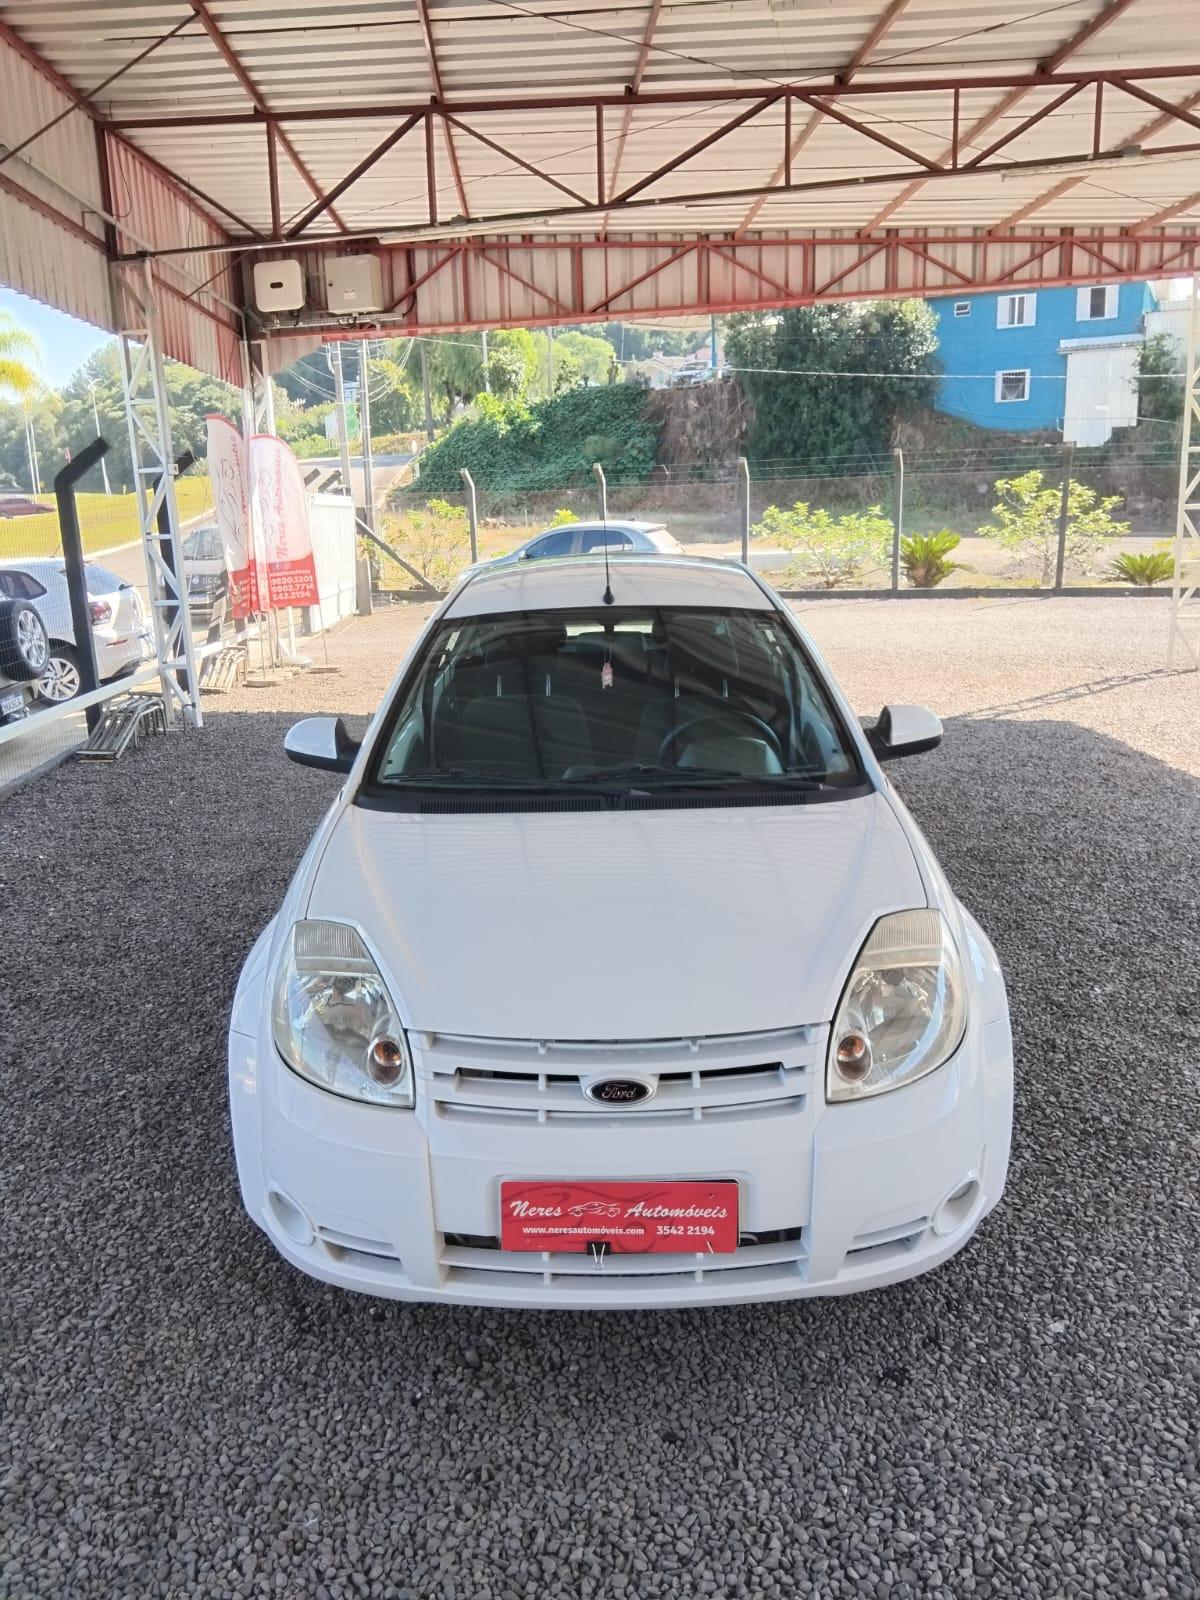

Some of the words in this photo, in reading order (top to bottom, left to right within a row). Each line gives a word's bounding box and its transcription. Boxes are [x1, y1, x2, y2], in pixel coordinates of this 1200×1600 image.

[601, 1083, 636, 1099] Ford
[509, 1200, 562, 1217] Neres
[623, 1200, 728, 1218] Automóveis
[656, 1225, 684, 1235] 3542
[687, 1225, 716, 1236] 2194
